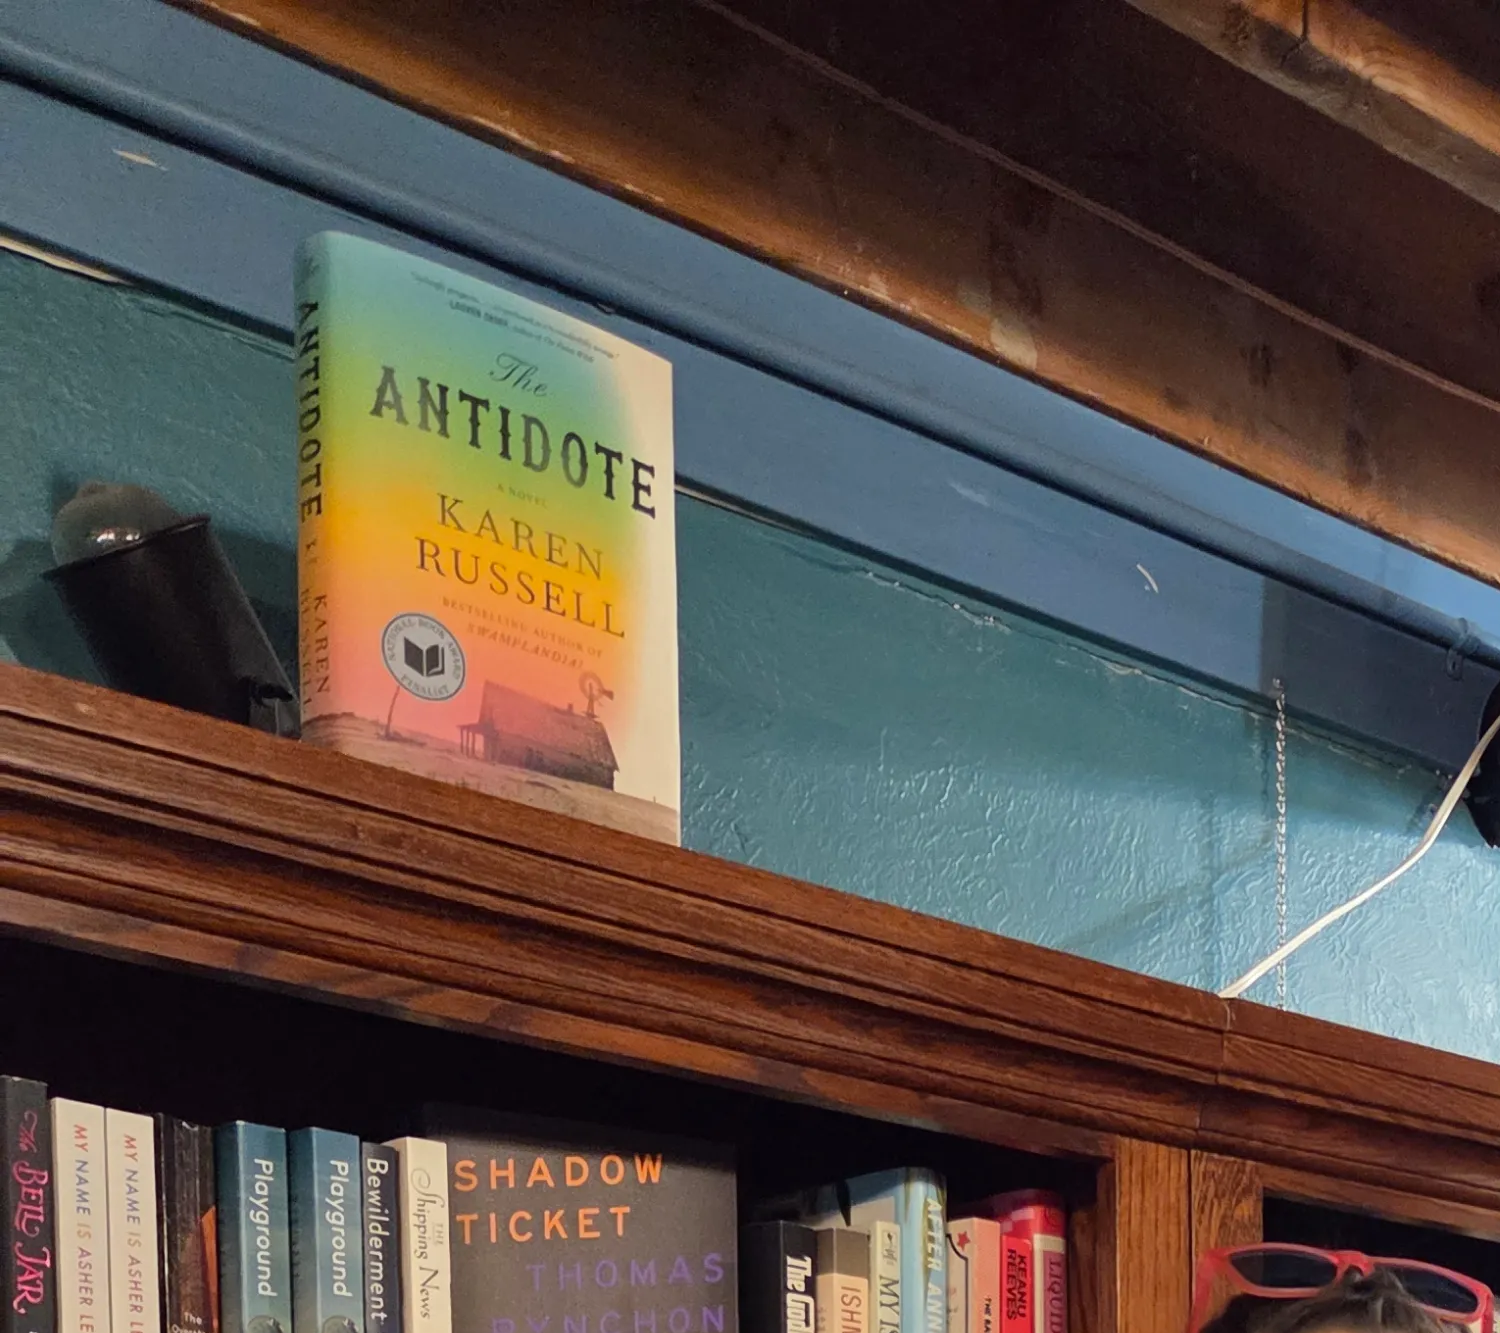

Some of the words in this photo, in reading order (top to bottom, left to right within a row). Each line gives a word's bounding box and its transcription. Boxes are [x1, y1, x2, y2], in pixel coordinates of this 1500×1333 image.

[490, 352, 548, 398] The
[298, 301, 323, 522] ANTIDOTE
[369, 365, 657, 519] ANTIDOTE
[437, 493, 604, 581] KAREN
[415, 536, 626, 639] RUSSELL
[73, 1124, 89, 1153] MY
[75, 1159, 91, 1216] NAME
[453, 1153, 665, 1193] SHADOW
[76, 1223, 92, 1238] IS
[250, 1158, 277, 1298] Playground
[365, 1156, 388, 1322] Bewilderment
[410, 1167, 446, 1262] Shipping
[455, 1205, 633, 1246] TICKET
[13, 1242, 52, 1314] JAR
[77, 1246, 94, 1306] ASHER
[418, 1267, 441, 1320] News
[526, 1252, 728, 1292] THOMAS
[785, 1255, 813, 1290] The
[879, 1274, 900, 1308] MY
[1006, 1248, 1017, 1321] REEVES
[1016, 1254, 1028, 1319] KEANU
[183, 1312, 203, 1326] The
